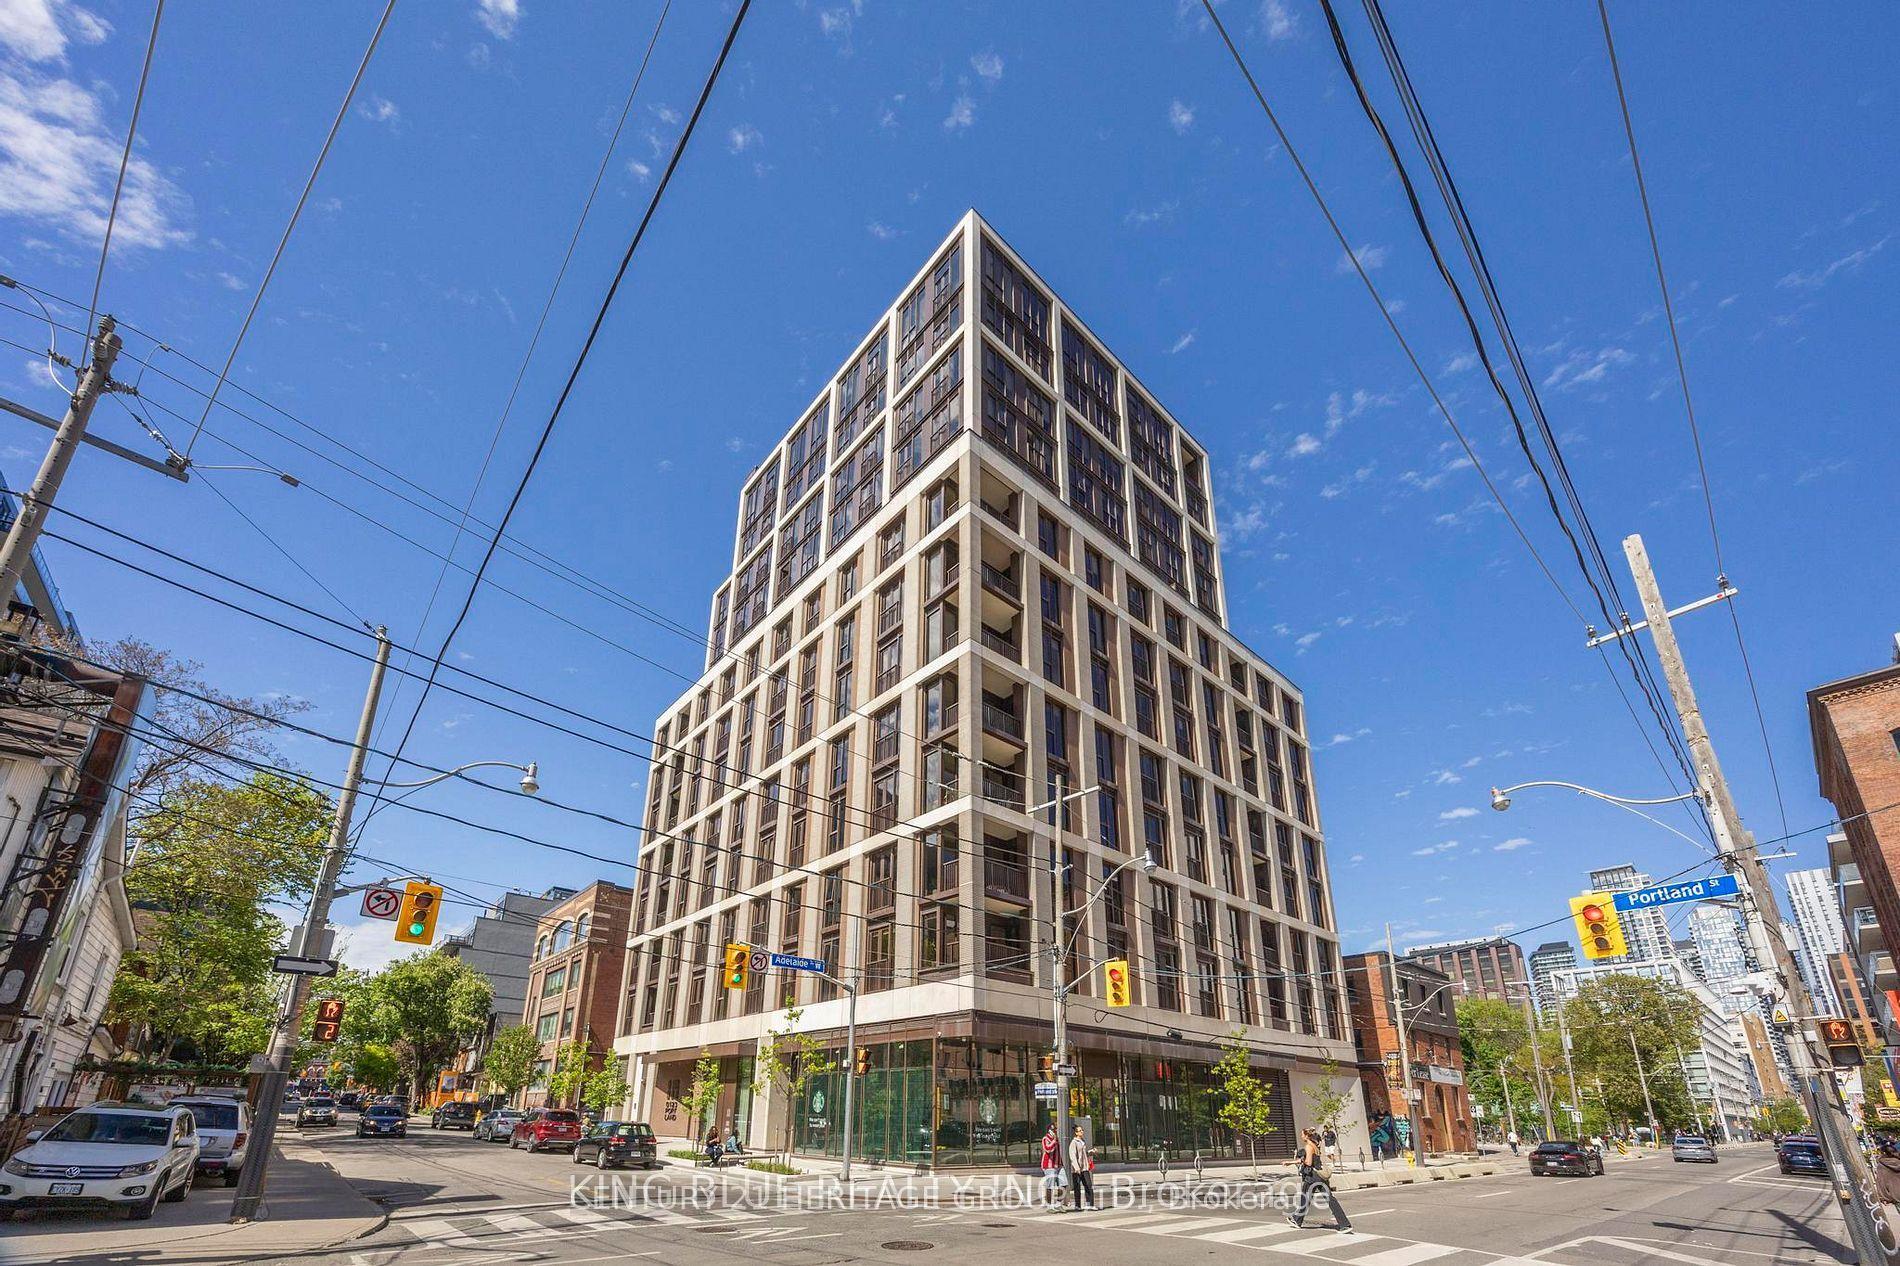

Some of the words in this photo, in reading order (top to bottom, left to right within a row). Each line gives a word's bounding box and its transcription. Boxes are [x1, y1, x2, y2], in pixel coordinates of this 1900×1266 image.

[1628, 882, 1704, 906] Portland
[1709, 877, 1720, 887] St
[775, 956, 808, 968] Adelaide
[324, 1025, 334, 1039] 2
